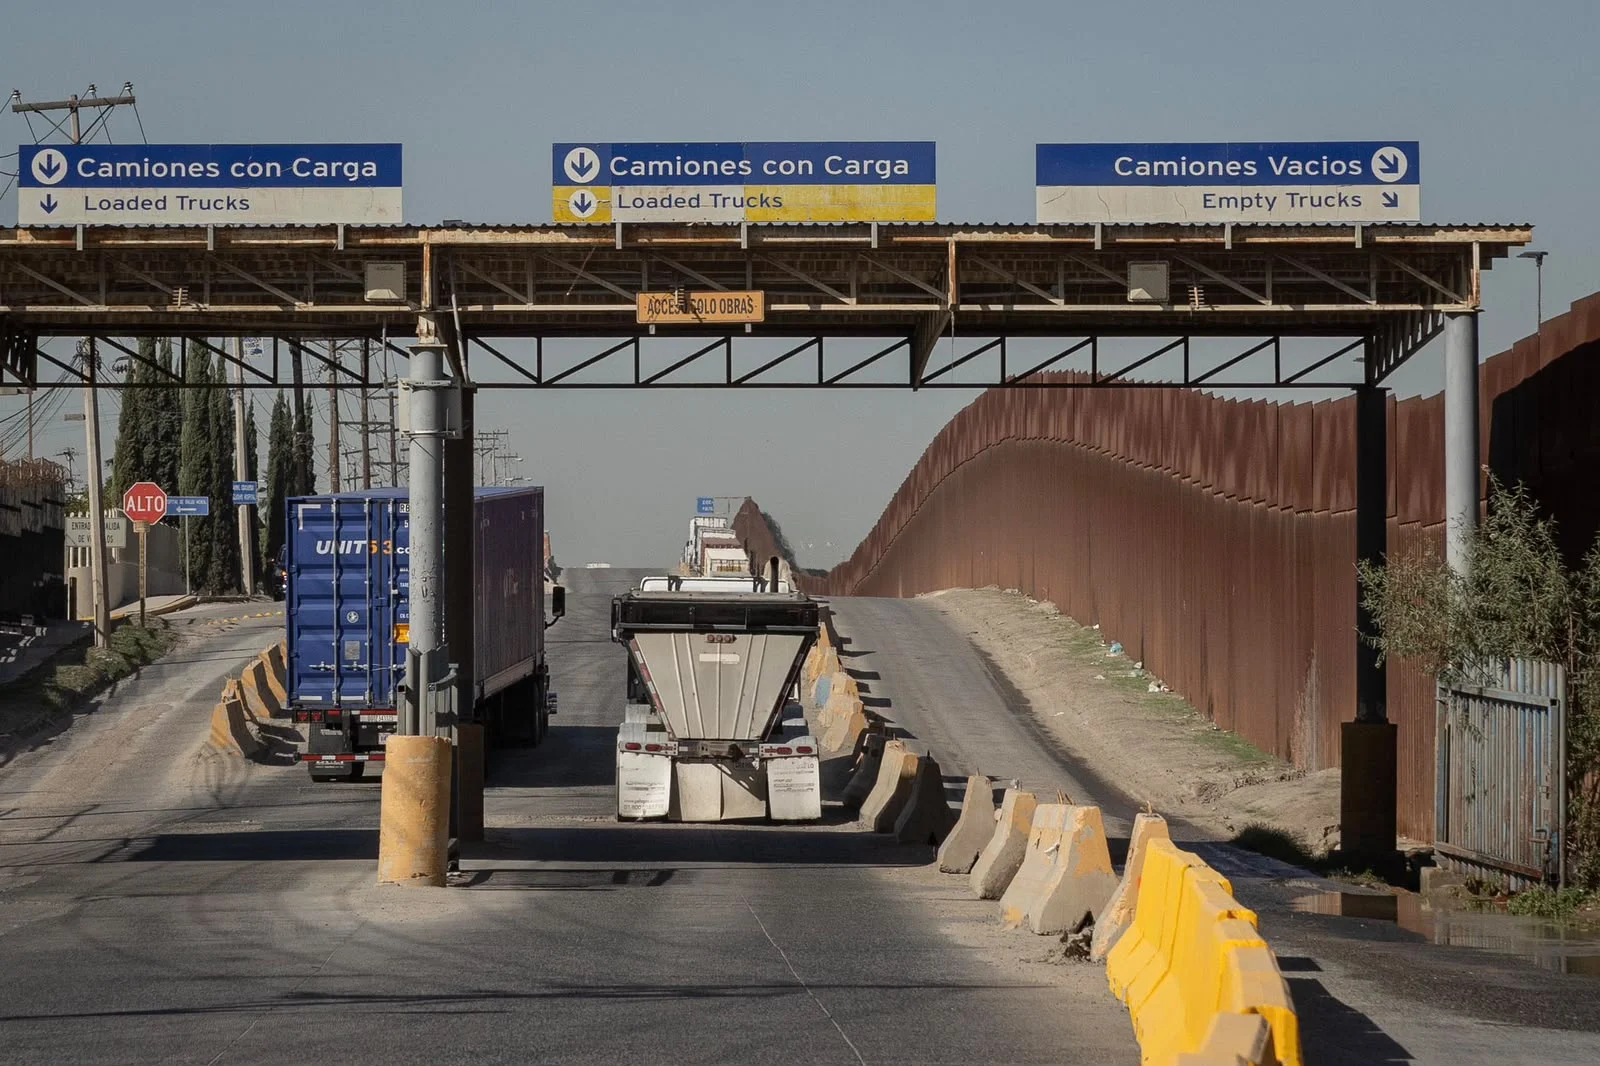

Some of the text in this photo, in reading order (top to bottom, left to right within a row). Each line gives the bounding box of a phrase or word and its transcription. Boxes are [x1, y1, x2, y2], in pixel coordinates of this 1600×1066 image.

[77, 157, 377, 182] Camiones con Carga
[609, 155, 909, 180] Camiones con Carga
[1114, 155, 1363, 176] Camiones Vacios
[84, 195, 250, 211] Loaded Trucks
[618, 192, 783, 209] Loaded Trucks
[1203, 191, 1362, 212] Empty Trucks
[690, 298, 717, 315] SOLO
[719, 297, 754, 315] OBRAS
[125, 495, 165, 514] ALTO
[71, 521, 91, 531] ENTRAD
[77, 535, 85, 543] DE
